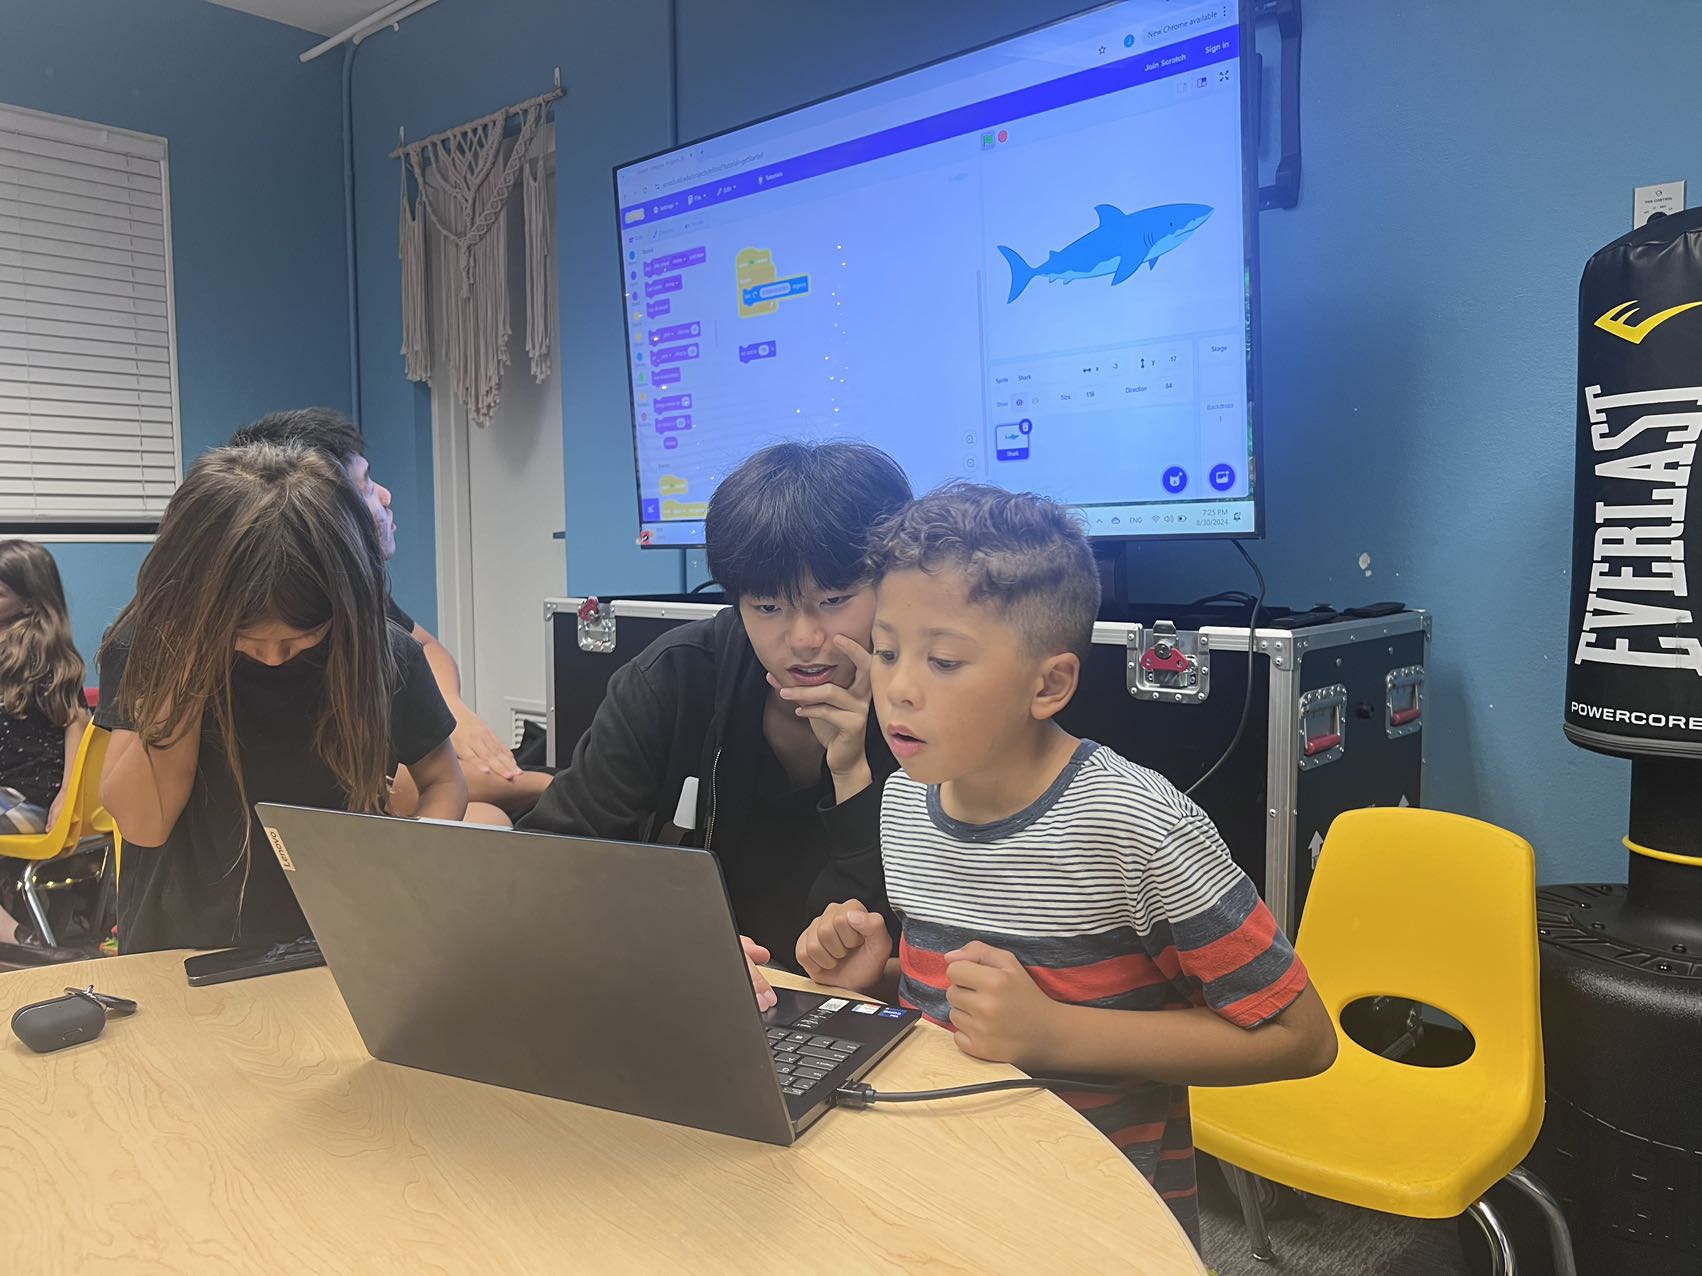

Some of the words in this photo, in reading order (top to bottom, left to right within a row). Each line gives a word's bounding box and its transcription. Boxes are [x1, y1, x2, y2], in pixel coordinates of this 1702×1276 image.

[1147, 30, 1161, 39] New
[1162, 21, 1188, 34] Chrome
[1189, 11, 1218, 26] available
[1204, 44, 1221, 54] Sign
[1144, 62, 1160, 72] Join
[1160, 54, 1187, 67] Scratch
[1125, 386, 1148, 394] Direction
[1129, 516, 1143, 524] ENG
[1202, 509, 1216, 517] 7:25
[1217, 508, 1229, 516] PM
[1574, 384, 1702, 677] EVERLAST
[1571, 702, 1702, 730] POWERCORE
[270, 831, 291, 868] Lenovo
